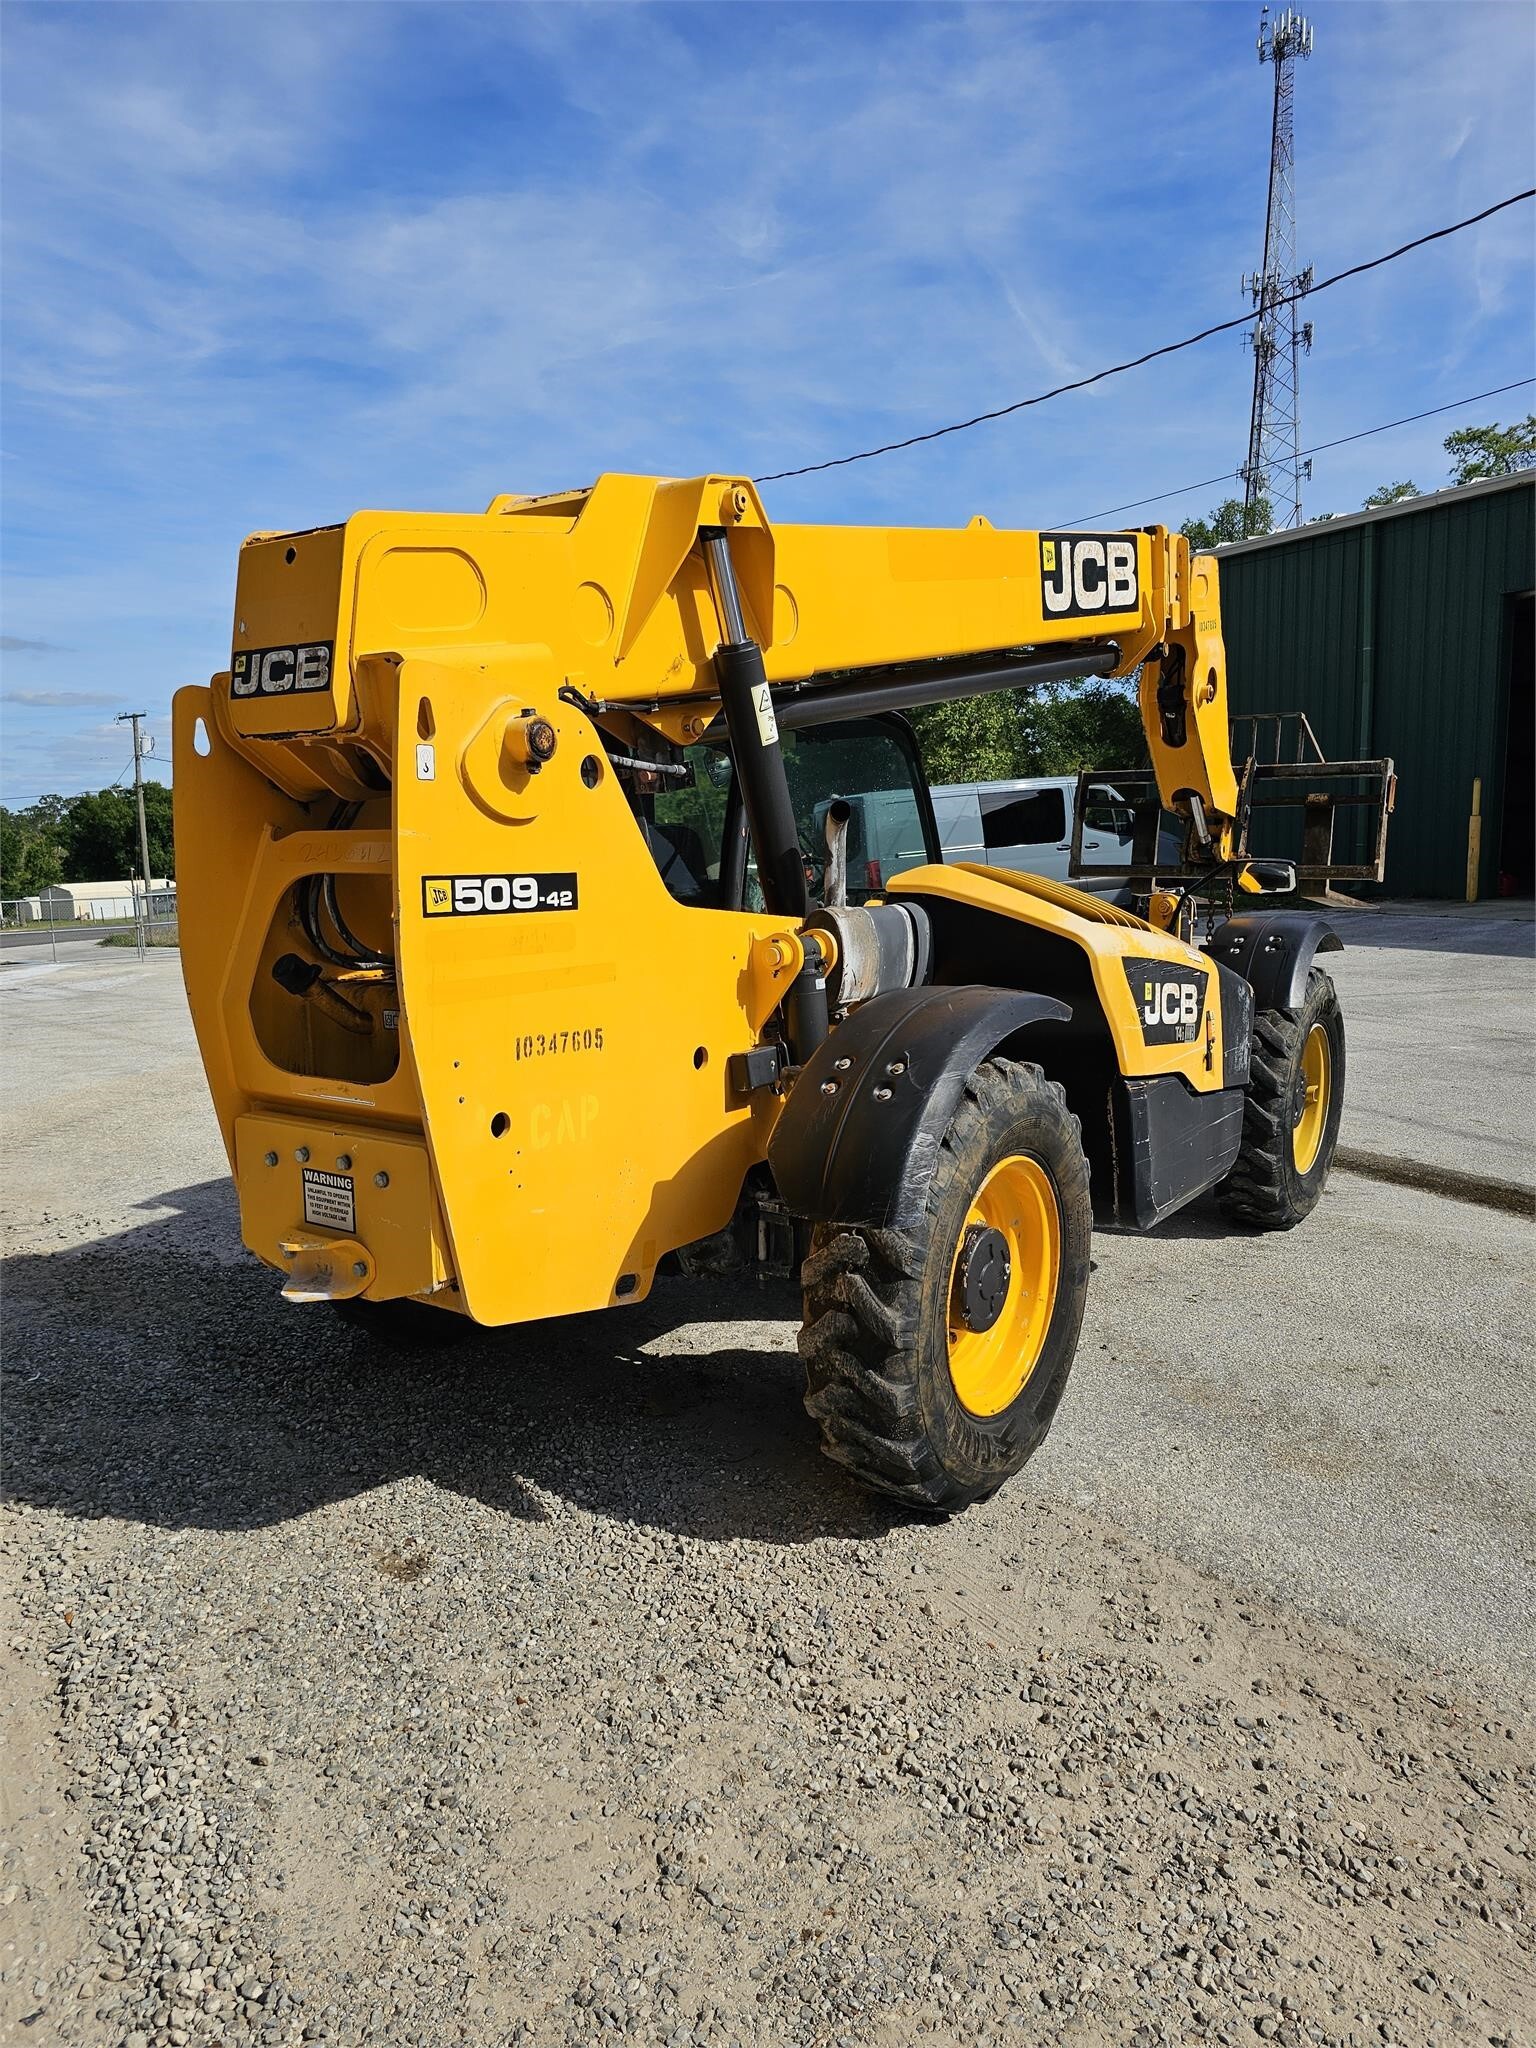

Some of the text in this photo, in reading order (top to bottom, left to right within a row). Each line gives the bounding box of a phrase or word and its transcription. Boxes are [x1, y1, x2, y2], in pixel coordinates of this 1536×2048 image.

[1044, 540, 1137, 612] JCB
[234, 646, 330, 695] JCB
[432, 877, 573, 912] JCB 509-42
[1144, 982, 1198, 1025] JCB
[516, 1027, 604, 1061] 10347605
[530, 1094, 600, 1149] CAP
[303, 1169, 353, 1190] WARNING
[333, 1192, 349, 1201] OPERATE
[315, 1202, 323, 1210] FEET
[316, 1196, 337, 1206] EQUIPMENT
[322, 1211, 337, 1220] VOLTAGE
